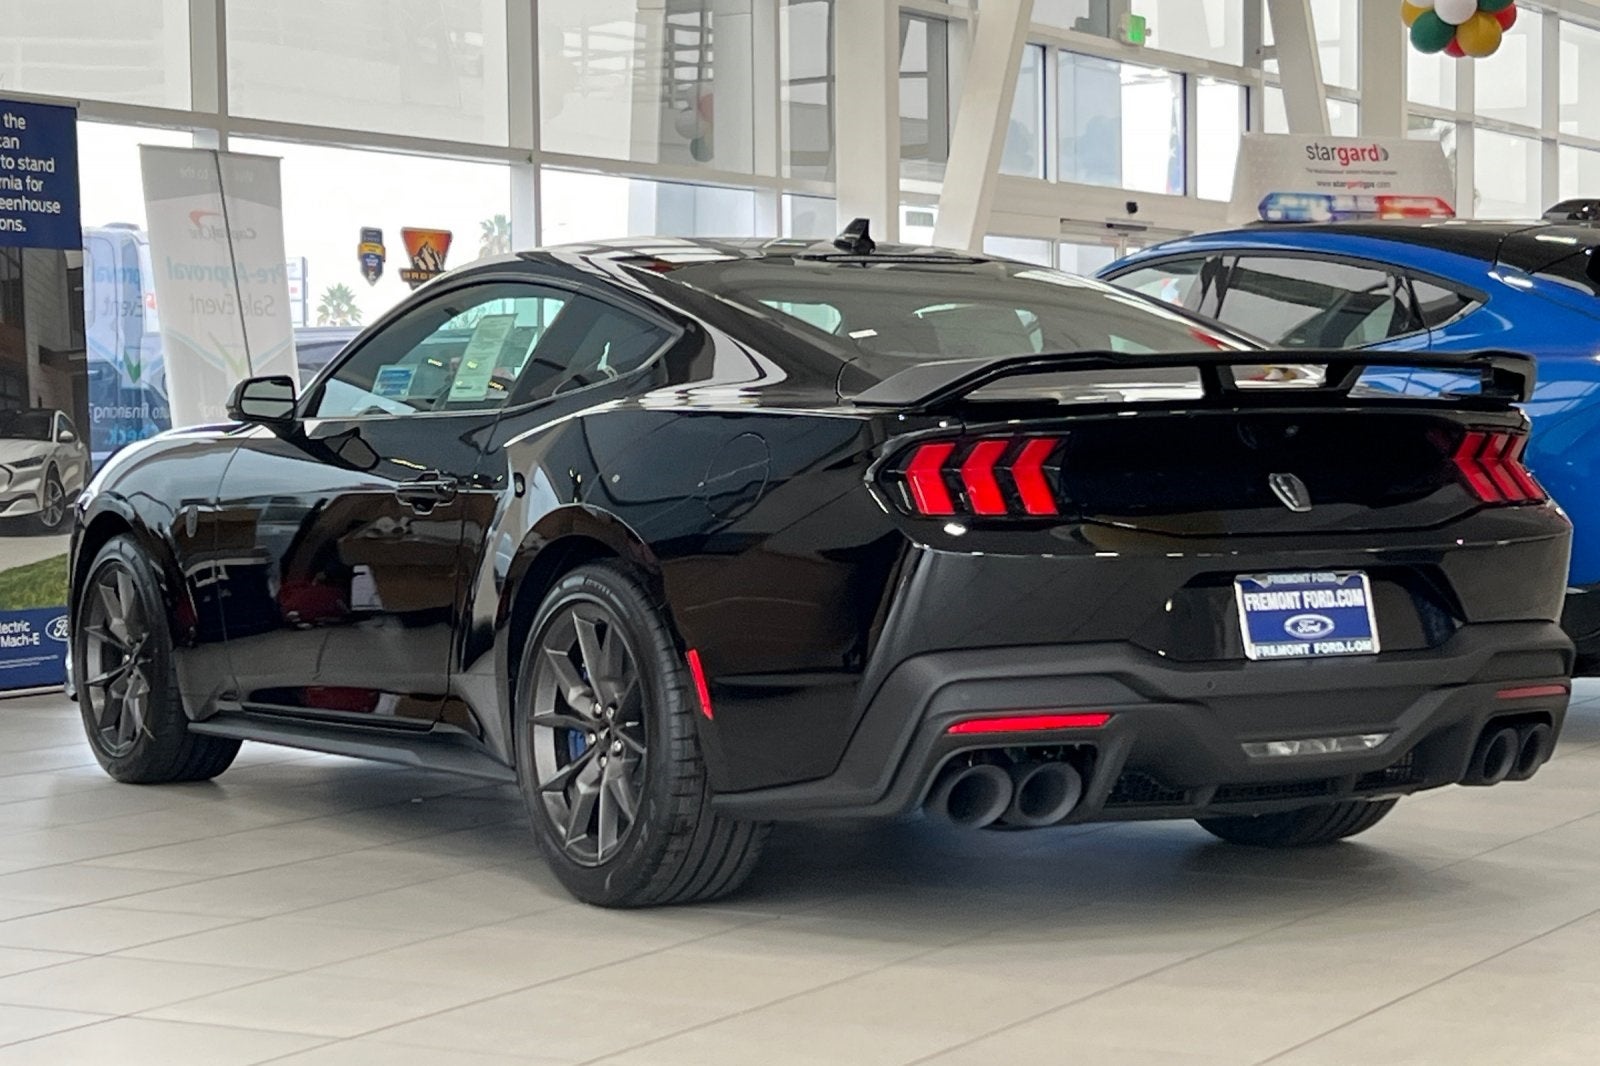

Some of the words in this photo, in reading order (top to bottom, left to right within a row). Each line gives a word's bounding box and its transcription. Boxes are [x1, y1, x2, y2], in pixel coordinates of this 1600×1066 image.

[4, 113, 26, 130] the
[1306, 142, 1380, 166] stargard
[0, 154, 15, 170] to
[17, 156, 55, 173] stand
[26, 174, 44, 192] for
[1311, 572, 1337, 583] FORD
[1244, 592, 1300, 611] FREMONT
[1304, 589, 1365, 608] FORD.COM
[1, 632, 40, 647] Mach-E
[1257, 643, 1310, 657] FREMONT
